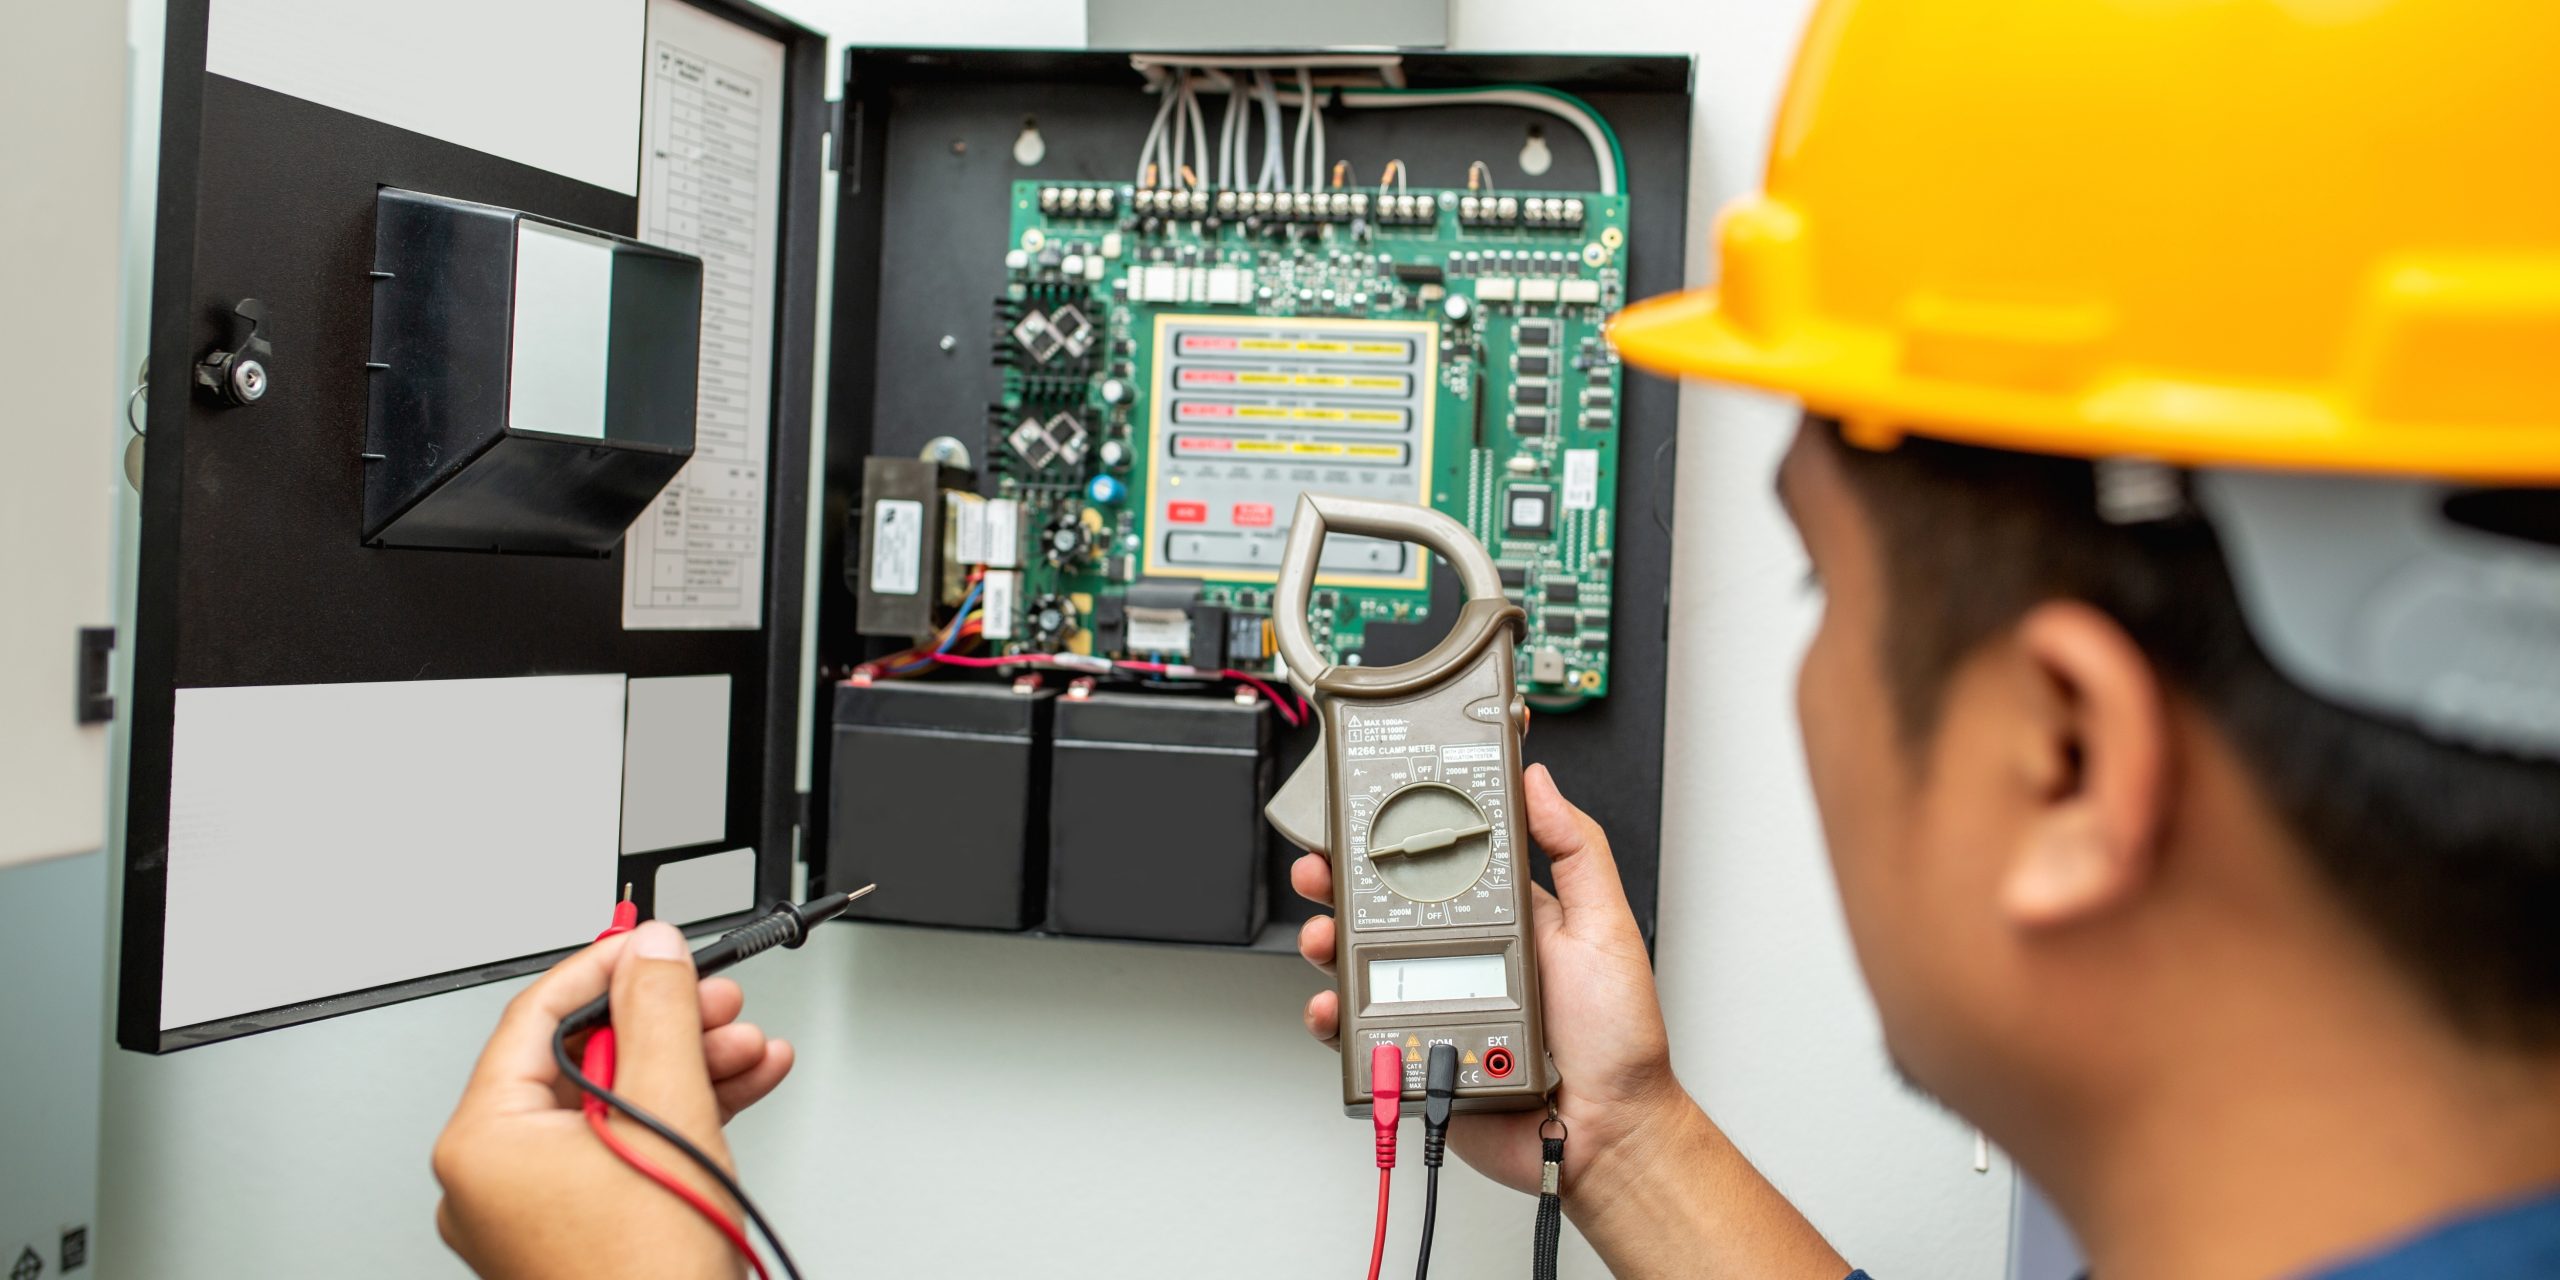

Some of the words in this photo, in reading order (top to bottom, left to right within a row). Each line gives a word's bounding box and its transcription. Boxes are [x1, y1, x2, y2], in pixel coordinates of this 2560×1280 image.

[1477, 707, 1500, 716] HOLD
[1364, 727, 1379, 735] CAT
[1348, 746, 1375, 756] M266
[1379, 747, 1407, 755] CLAMP
[1408, 745, 1436, 753] METER
[1417, 766, 1433, 774] OFF
[1471, 780, 1486, 788] 20M
[1369, 785, 1382, 793] 200
[1353, 809, 1366, 817] 750
[1494, 828, 1506, 836] 200
[1493, 867, 1506, 875] 750
[1476, 890, 1490, 898] 200
[1372, 895, 1388, 903] 20M
[1389, 908, 1412, 916] 2000M
[1454, 905, 1471, 913] 1000
[1427, 911, 1442, 920] OFF
[1358, 917, 1386, 925] EXTERNAL
[1487, 1036, 1508, 1046] EXT
